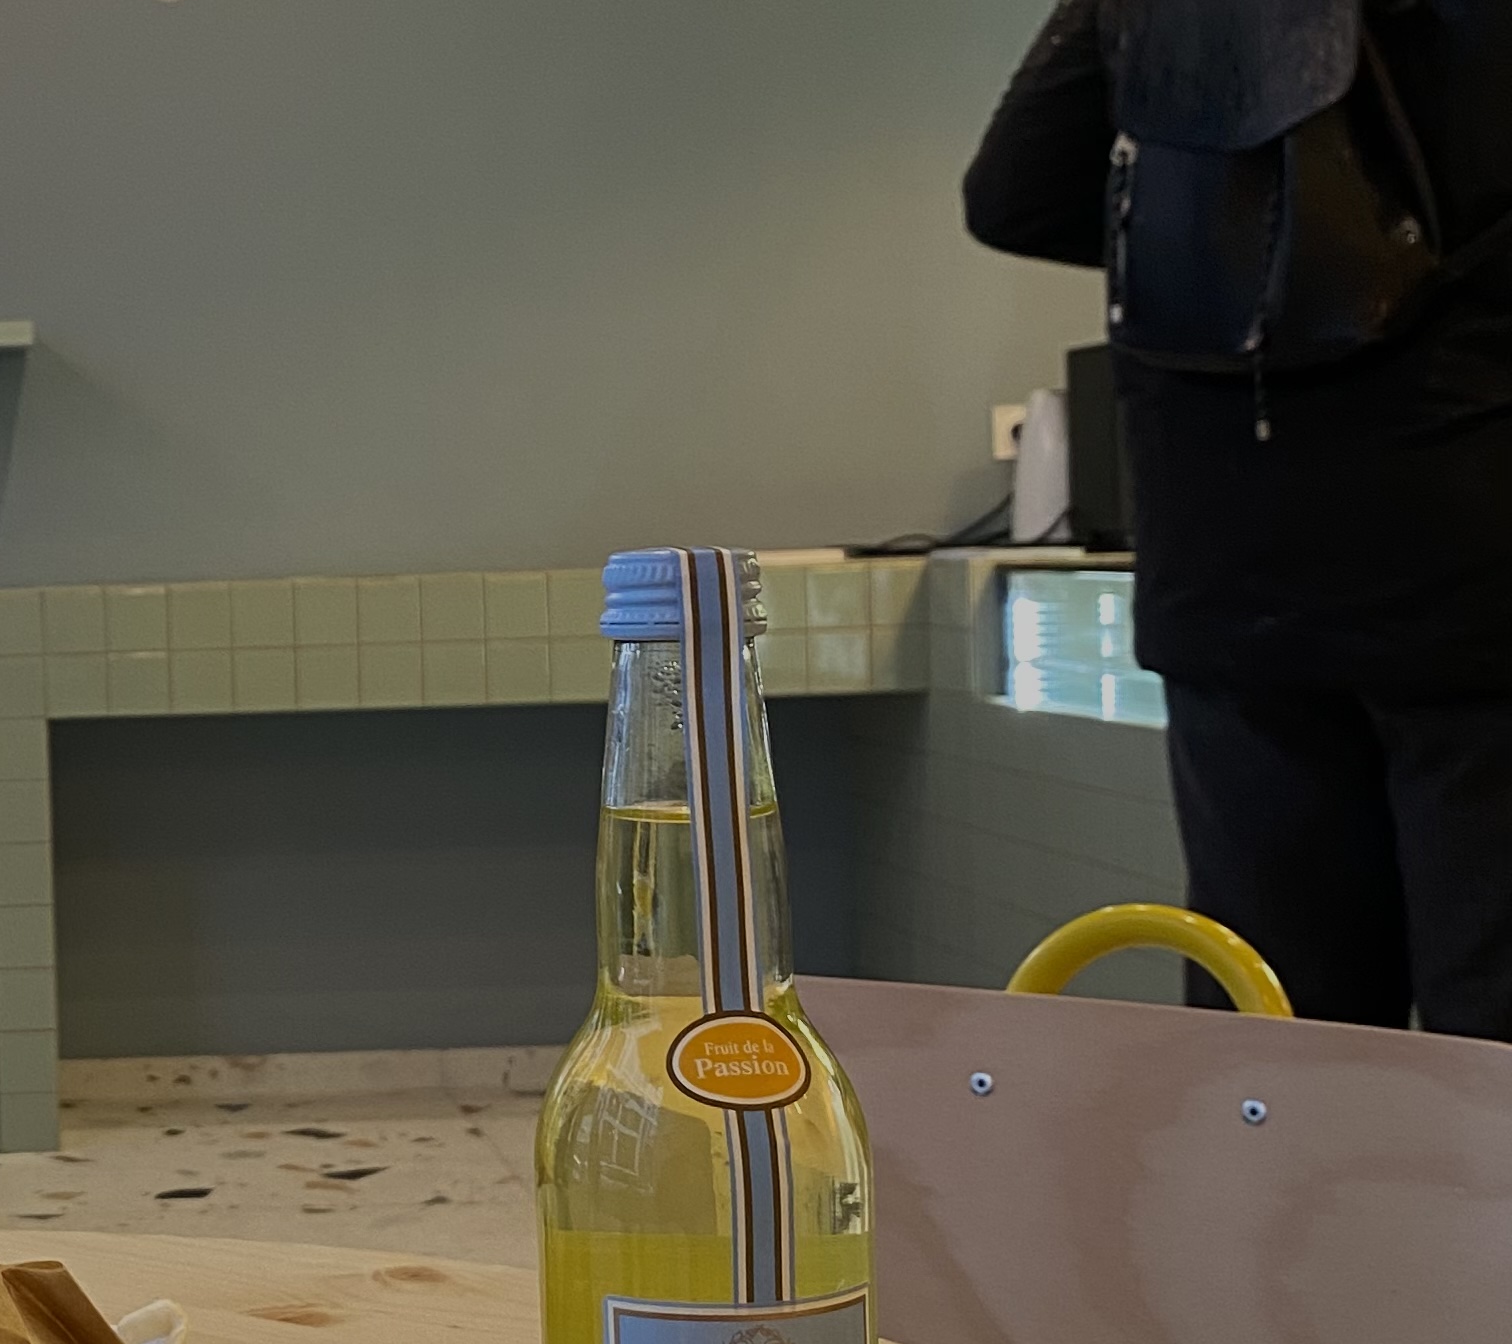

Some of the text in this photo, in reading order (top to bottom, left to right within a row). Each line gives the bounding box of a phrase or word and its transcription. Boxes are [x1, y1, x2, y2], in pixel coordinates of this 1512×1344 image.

[704, 1039, 775, 1056] Fruit de la
[694, 1056, 789, 1080] Passion
